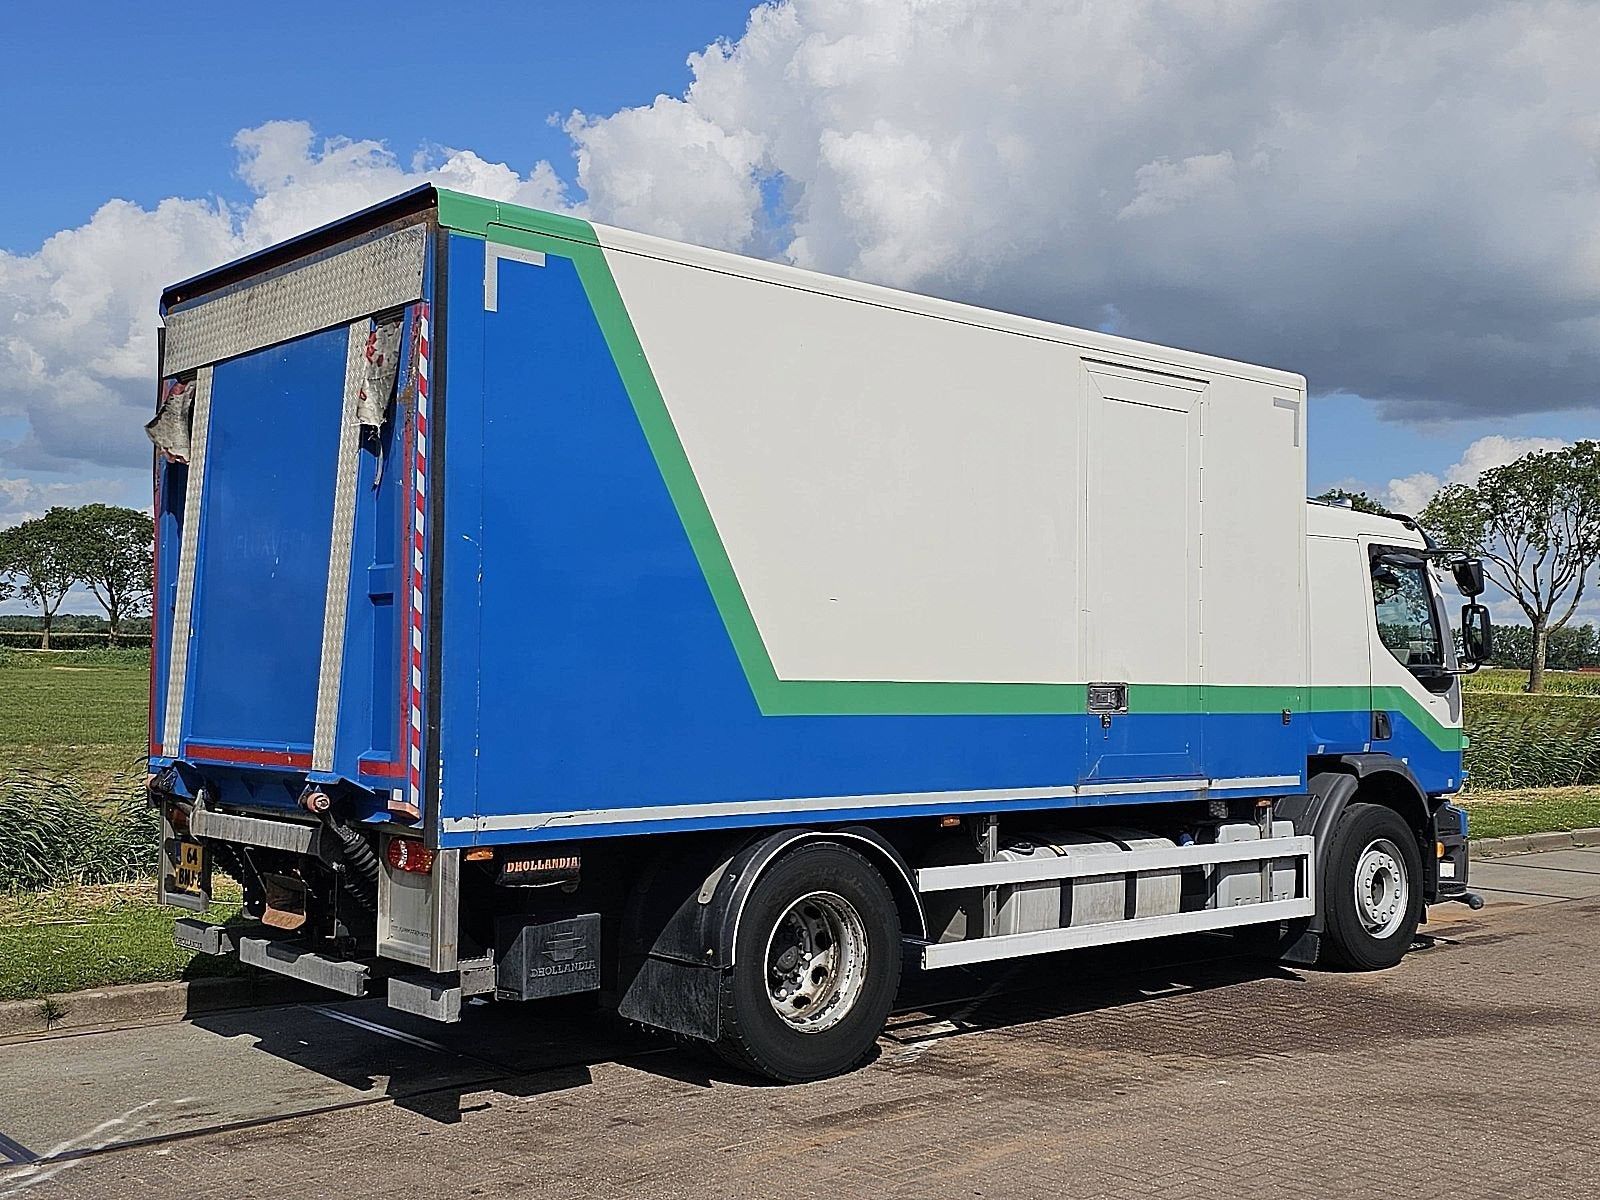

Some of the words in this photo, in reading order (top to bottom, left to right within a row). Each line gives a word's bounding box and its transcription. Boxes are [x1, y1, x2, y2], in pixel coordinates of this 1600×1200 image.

[186, 847, 198, 866] 64
[506, 856, 578, 873] DHOLLANDIA
[529, 959, 597, 978] DHOLLANDIA
